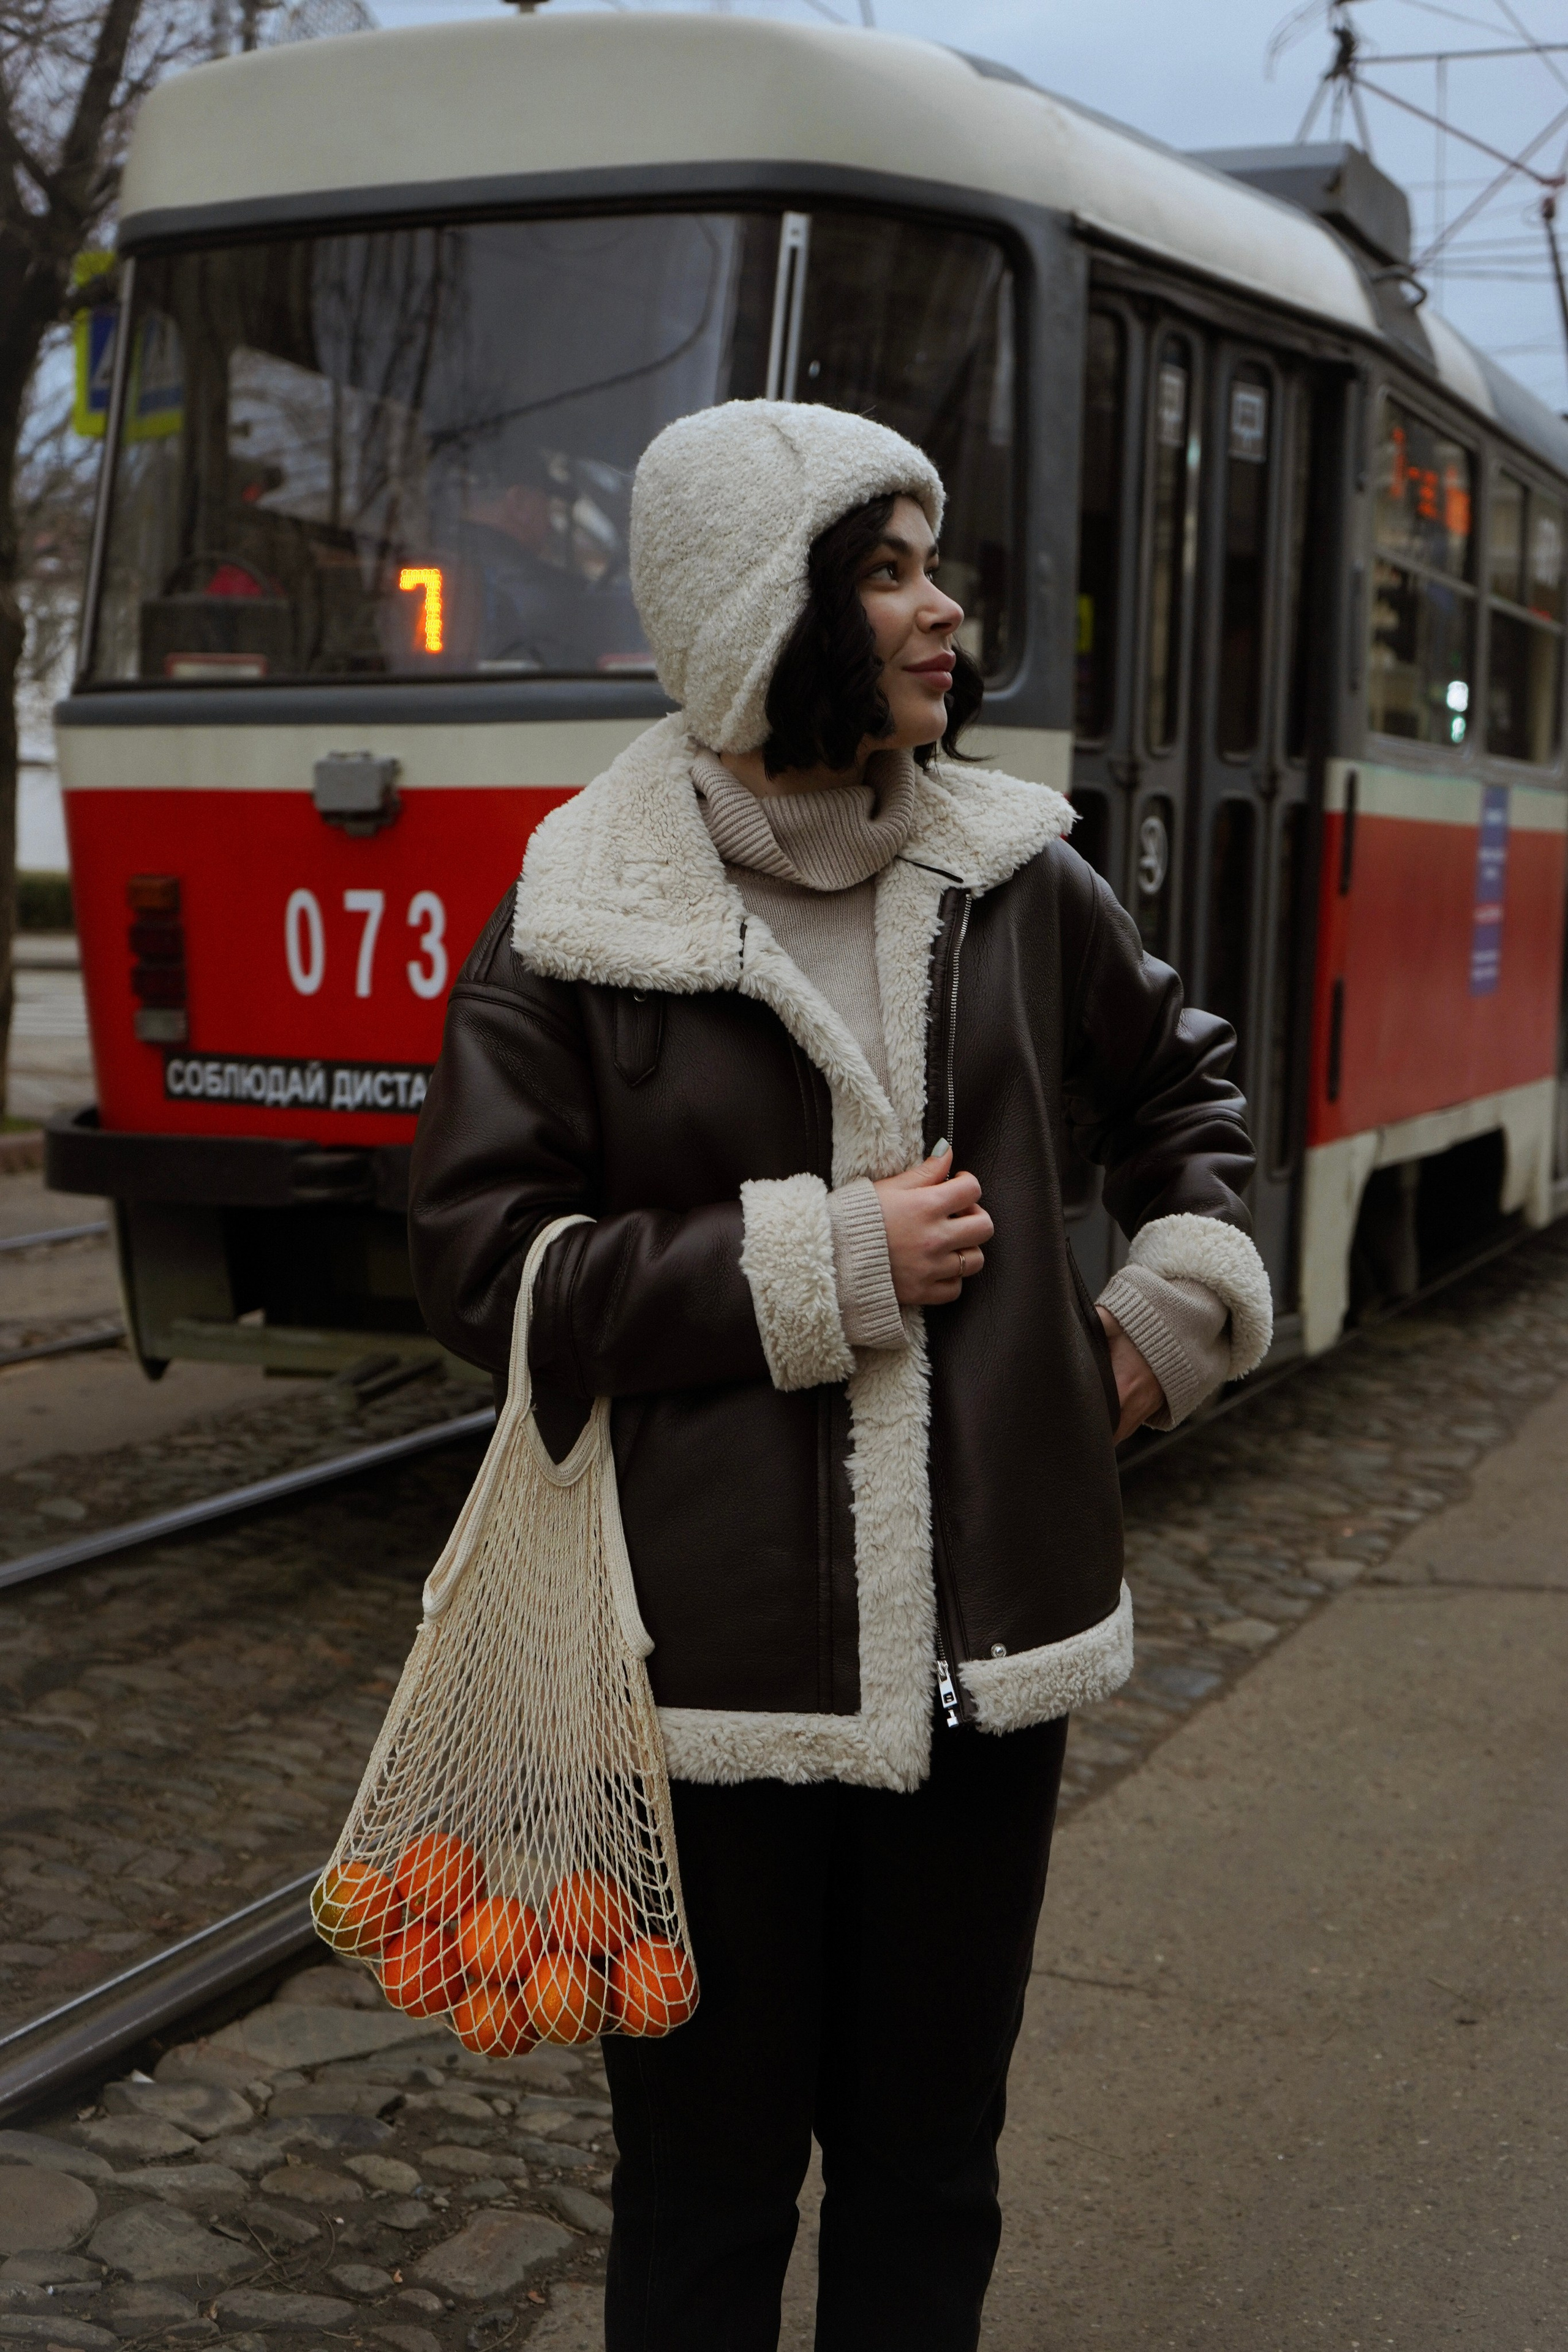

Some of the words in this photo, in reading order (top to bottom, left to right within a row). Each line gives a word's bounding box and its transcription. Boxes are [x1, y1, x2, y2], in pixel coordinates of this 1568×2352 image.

[400, 568, 442, 651] 7
[285, 888, 448, 999] 073
[167, 1059, 325, 1107] СОБЛЮДАЙ
[331, 1069, 432, 1110] ДИСТА
